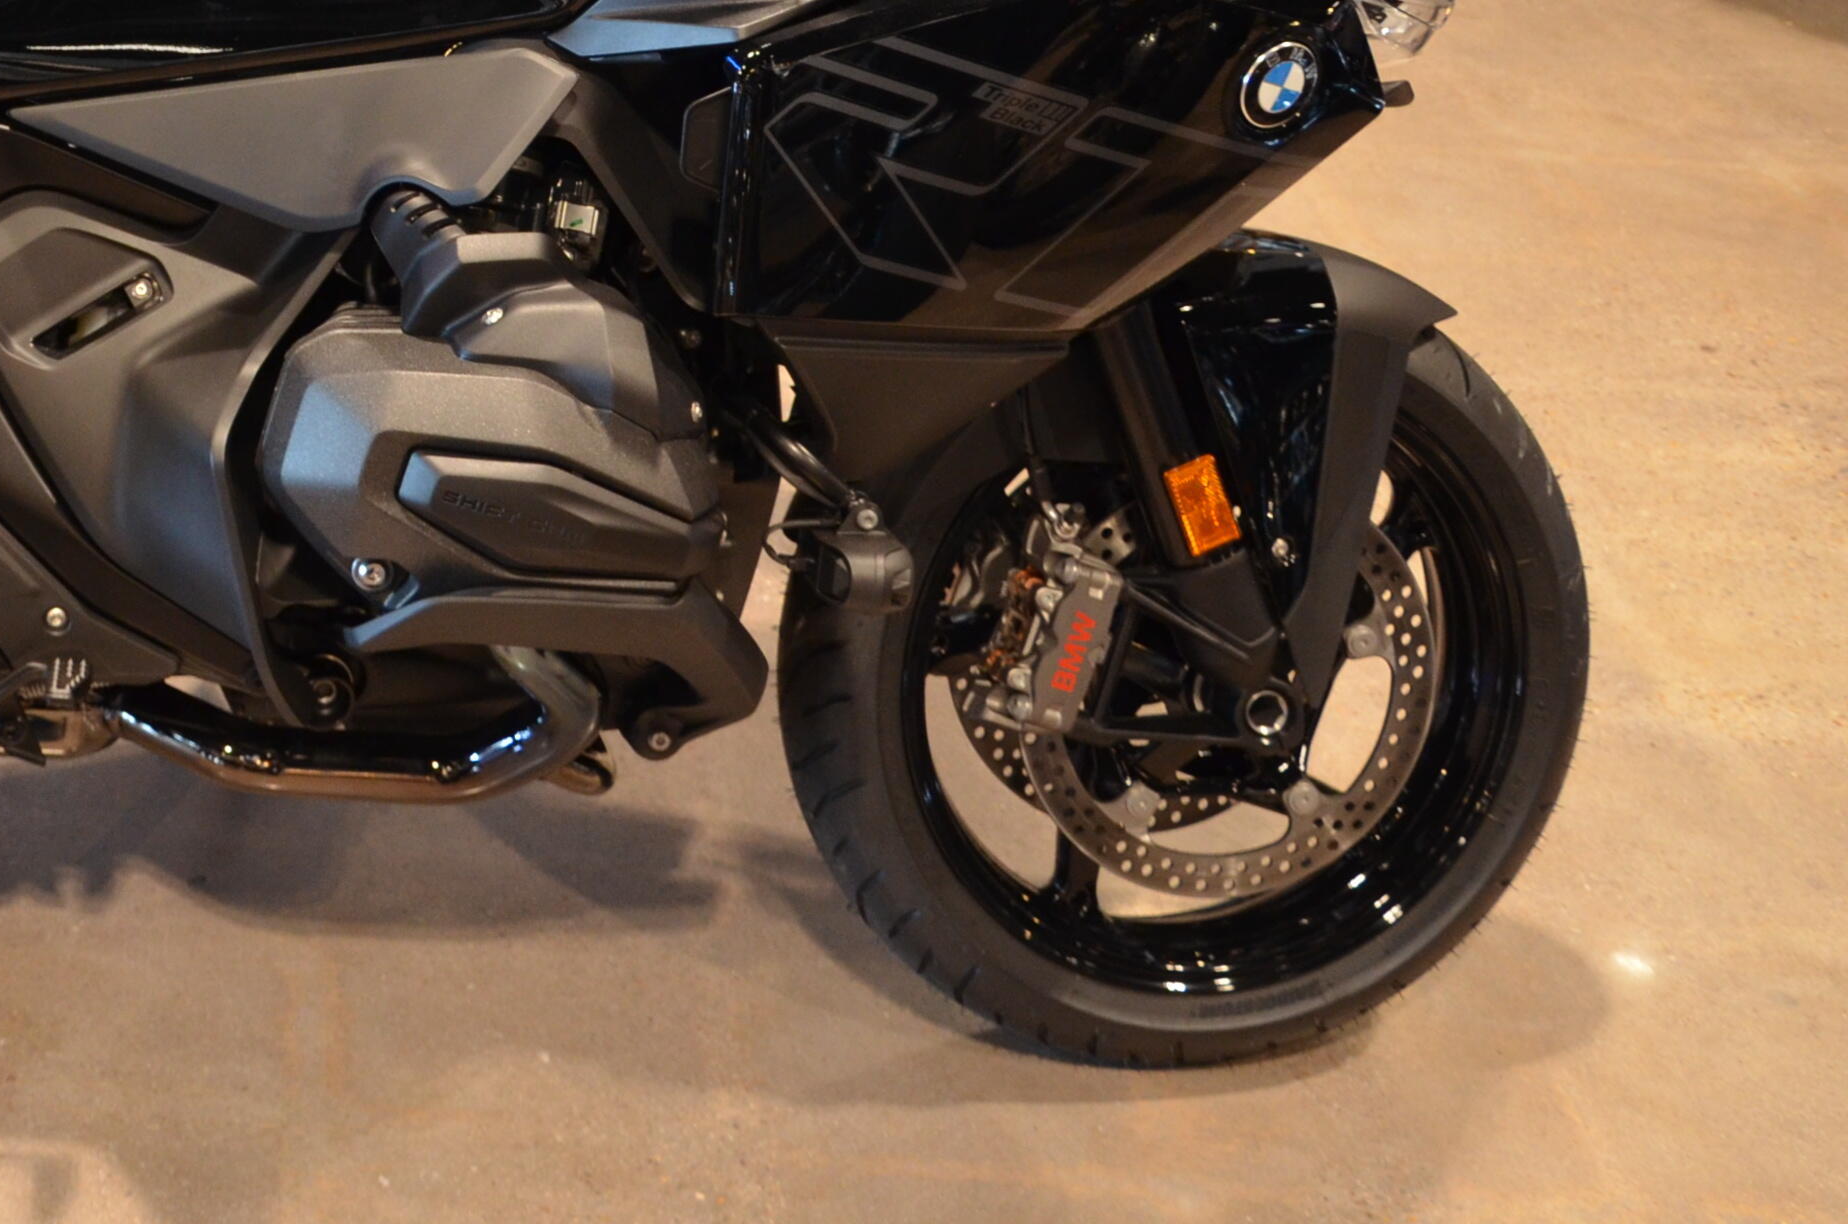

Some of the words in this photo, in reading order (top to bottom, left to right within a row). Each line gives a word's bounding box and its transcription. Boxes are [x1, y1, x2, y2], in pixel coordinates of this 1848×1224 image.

[983, 85, 1039, 112] Triple
[990, 106, 1046, 133] Black
[1050, 609, 1097, 693] BMW
